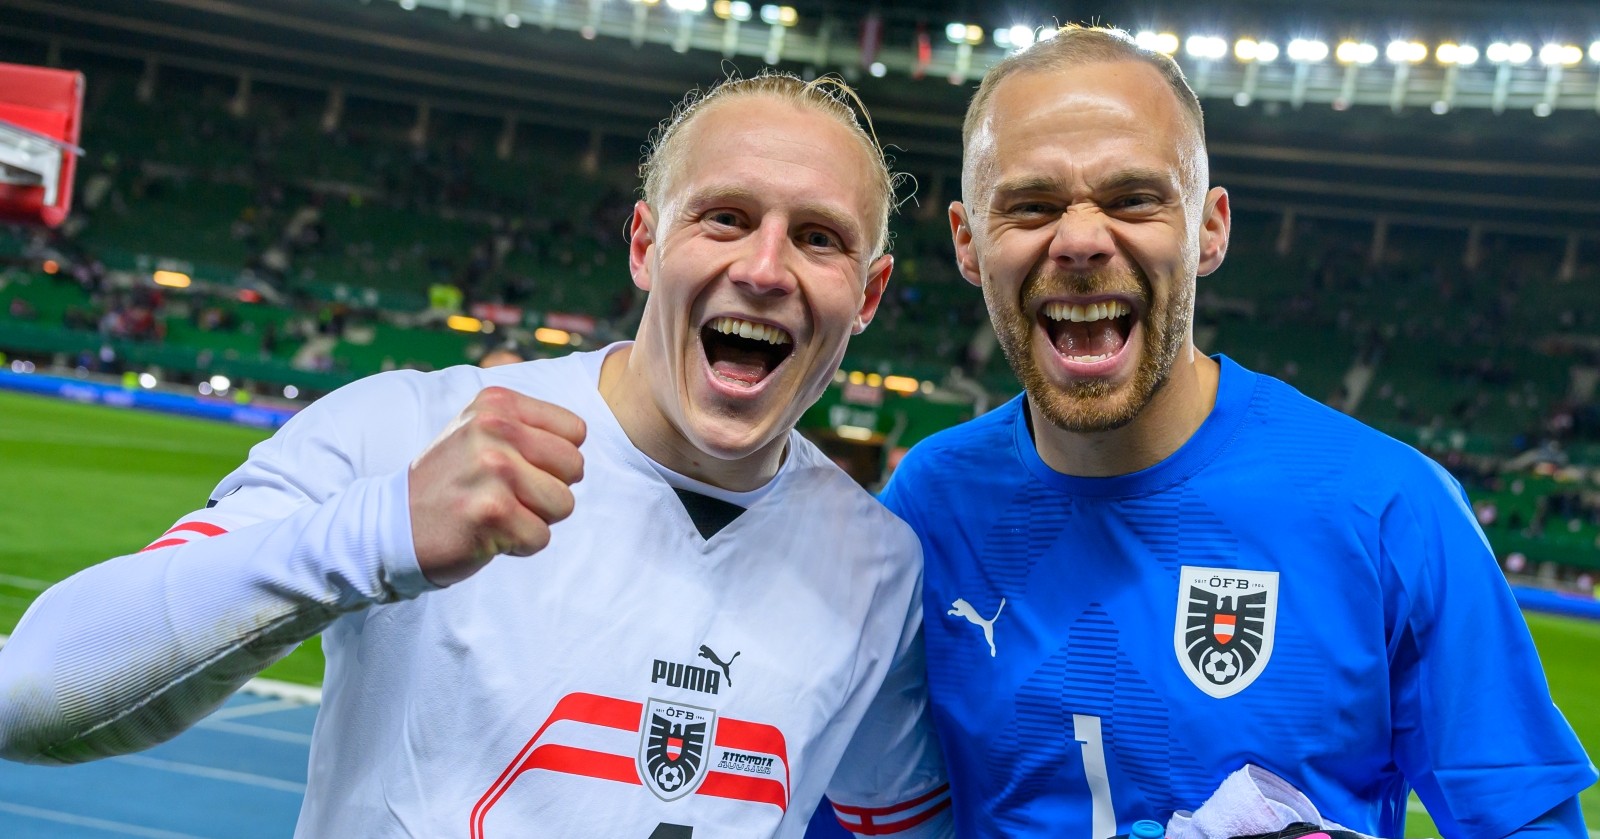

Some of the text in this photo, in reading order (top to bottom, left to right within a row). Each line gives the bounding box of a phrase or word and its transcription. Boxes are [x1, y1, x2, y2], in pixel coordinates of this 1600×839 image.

[1209, 575, 1249, 589] ÖFB
[651, 659, 720, 694] PUMA
[666, 706, 694, 720] ÖFB
[1073, 714, 1117, 839] 1
